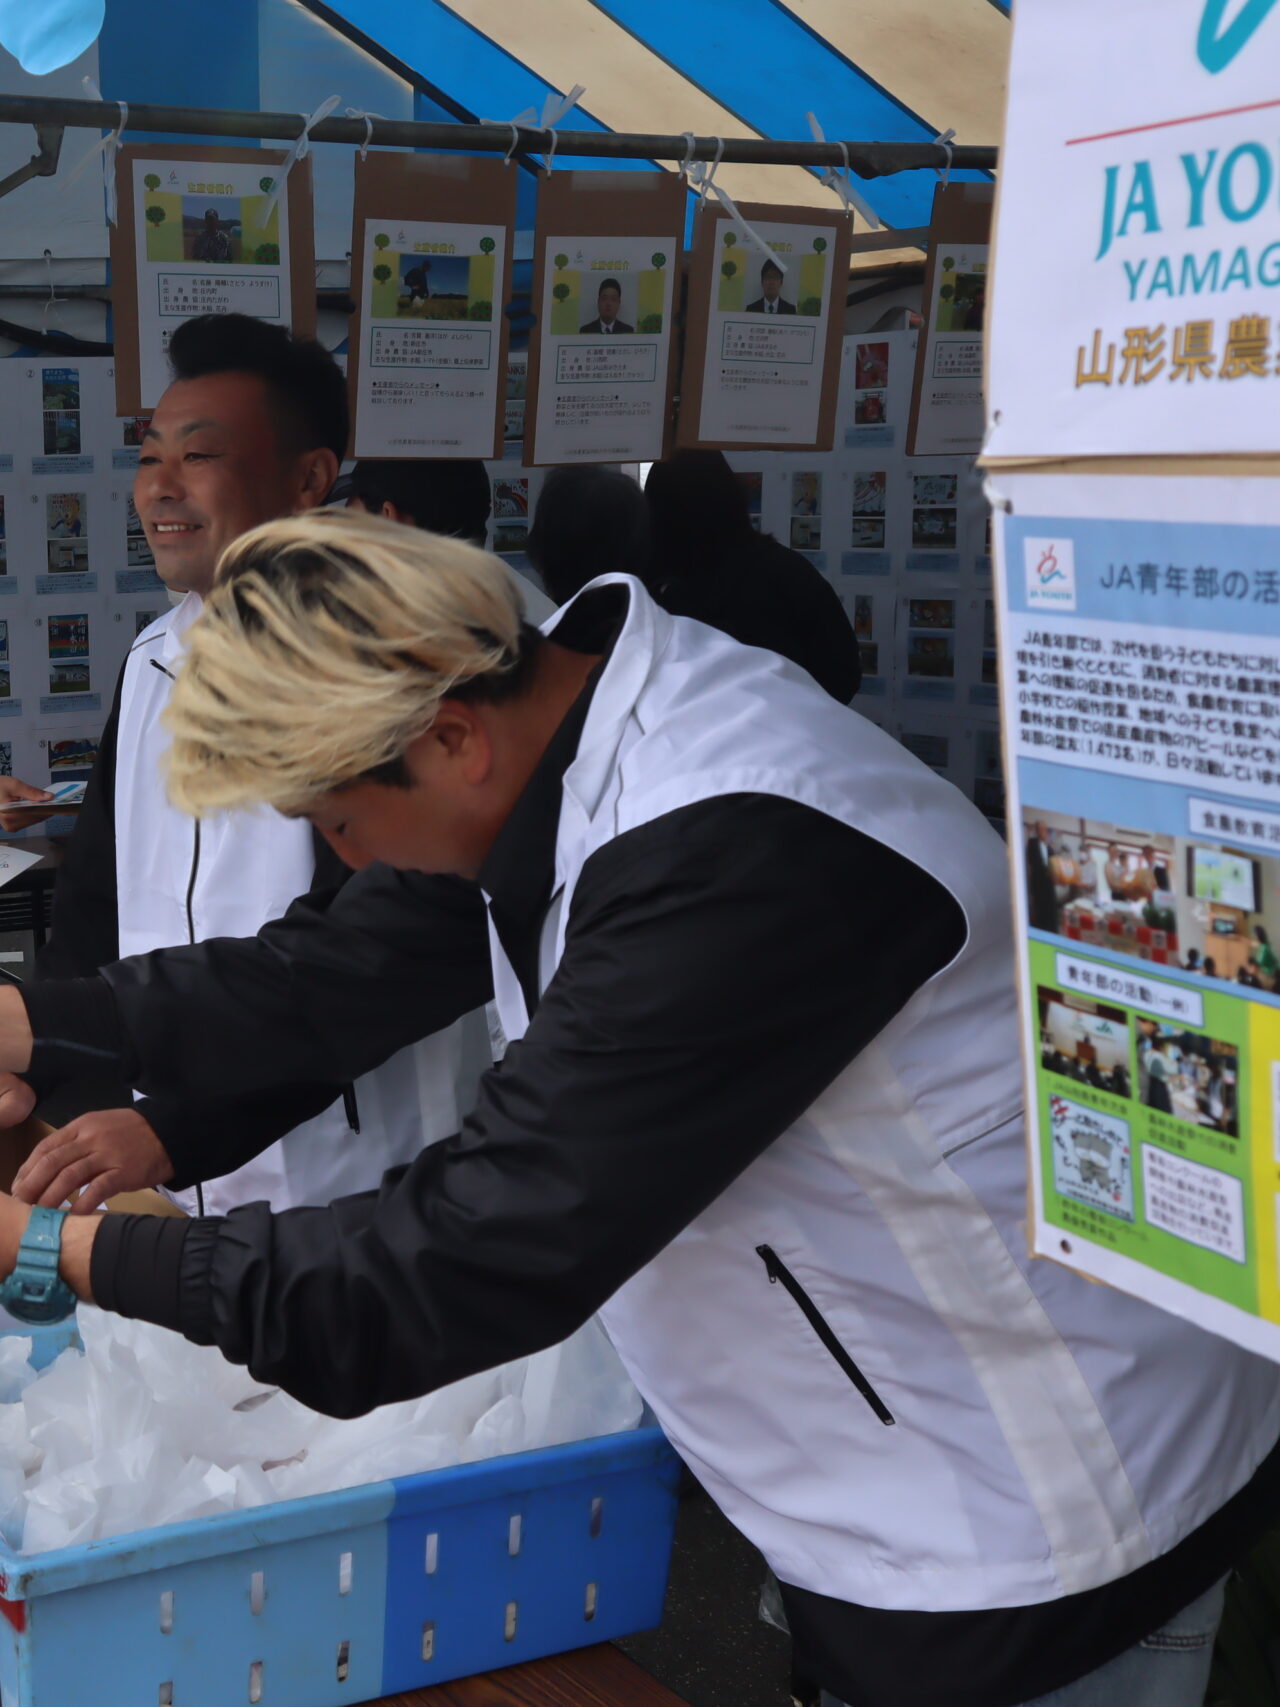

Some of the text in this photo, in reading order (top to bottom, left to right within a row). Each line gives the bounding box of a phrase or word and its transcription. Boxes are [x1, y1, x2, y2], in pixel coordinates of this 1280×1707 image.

[187, 183, 234, 195] 生産者紹介
[1095, 142, 1280, 262] JA YO
[1075, 314, 1280, 389] 山形県農
[1100, 562, 1280, 604] JA青年部の活
